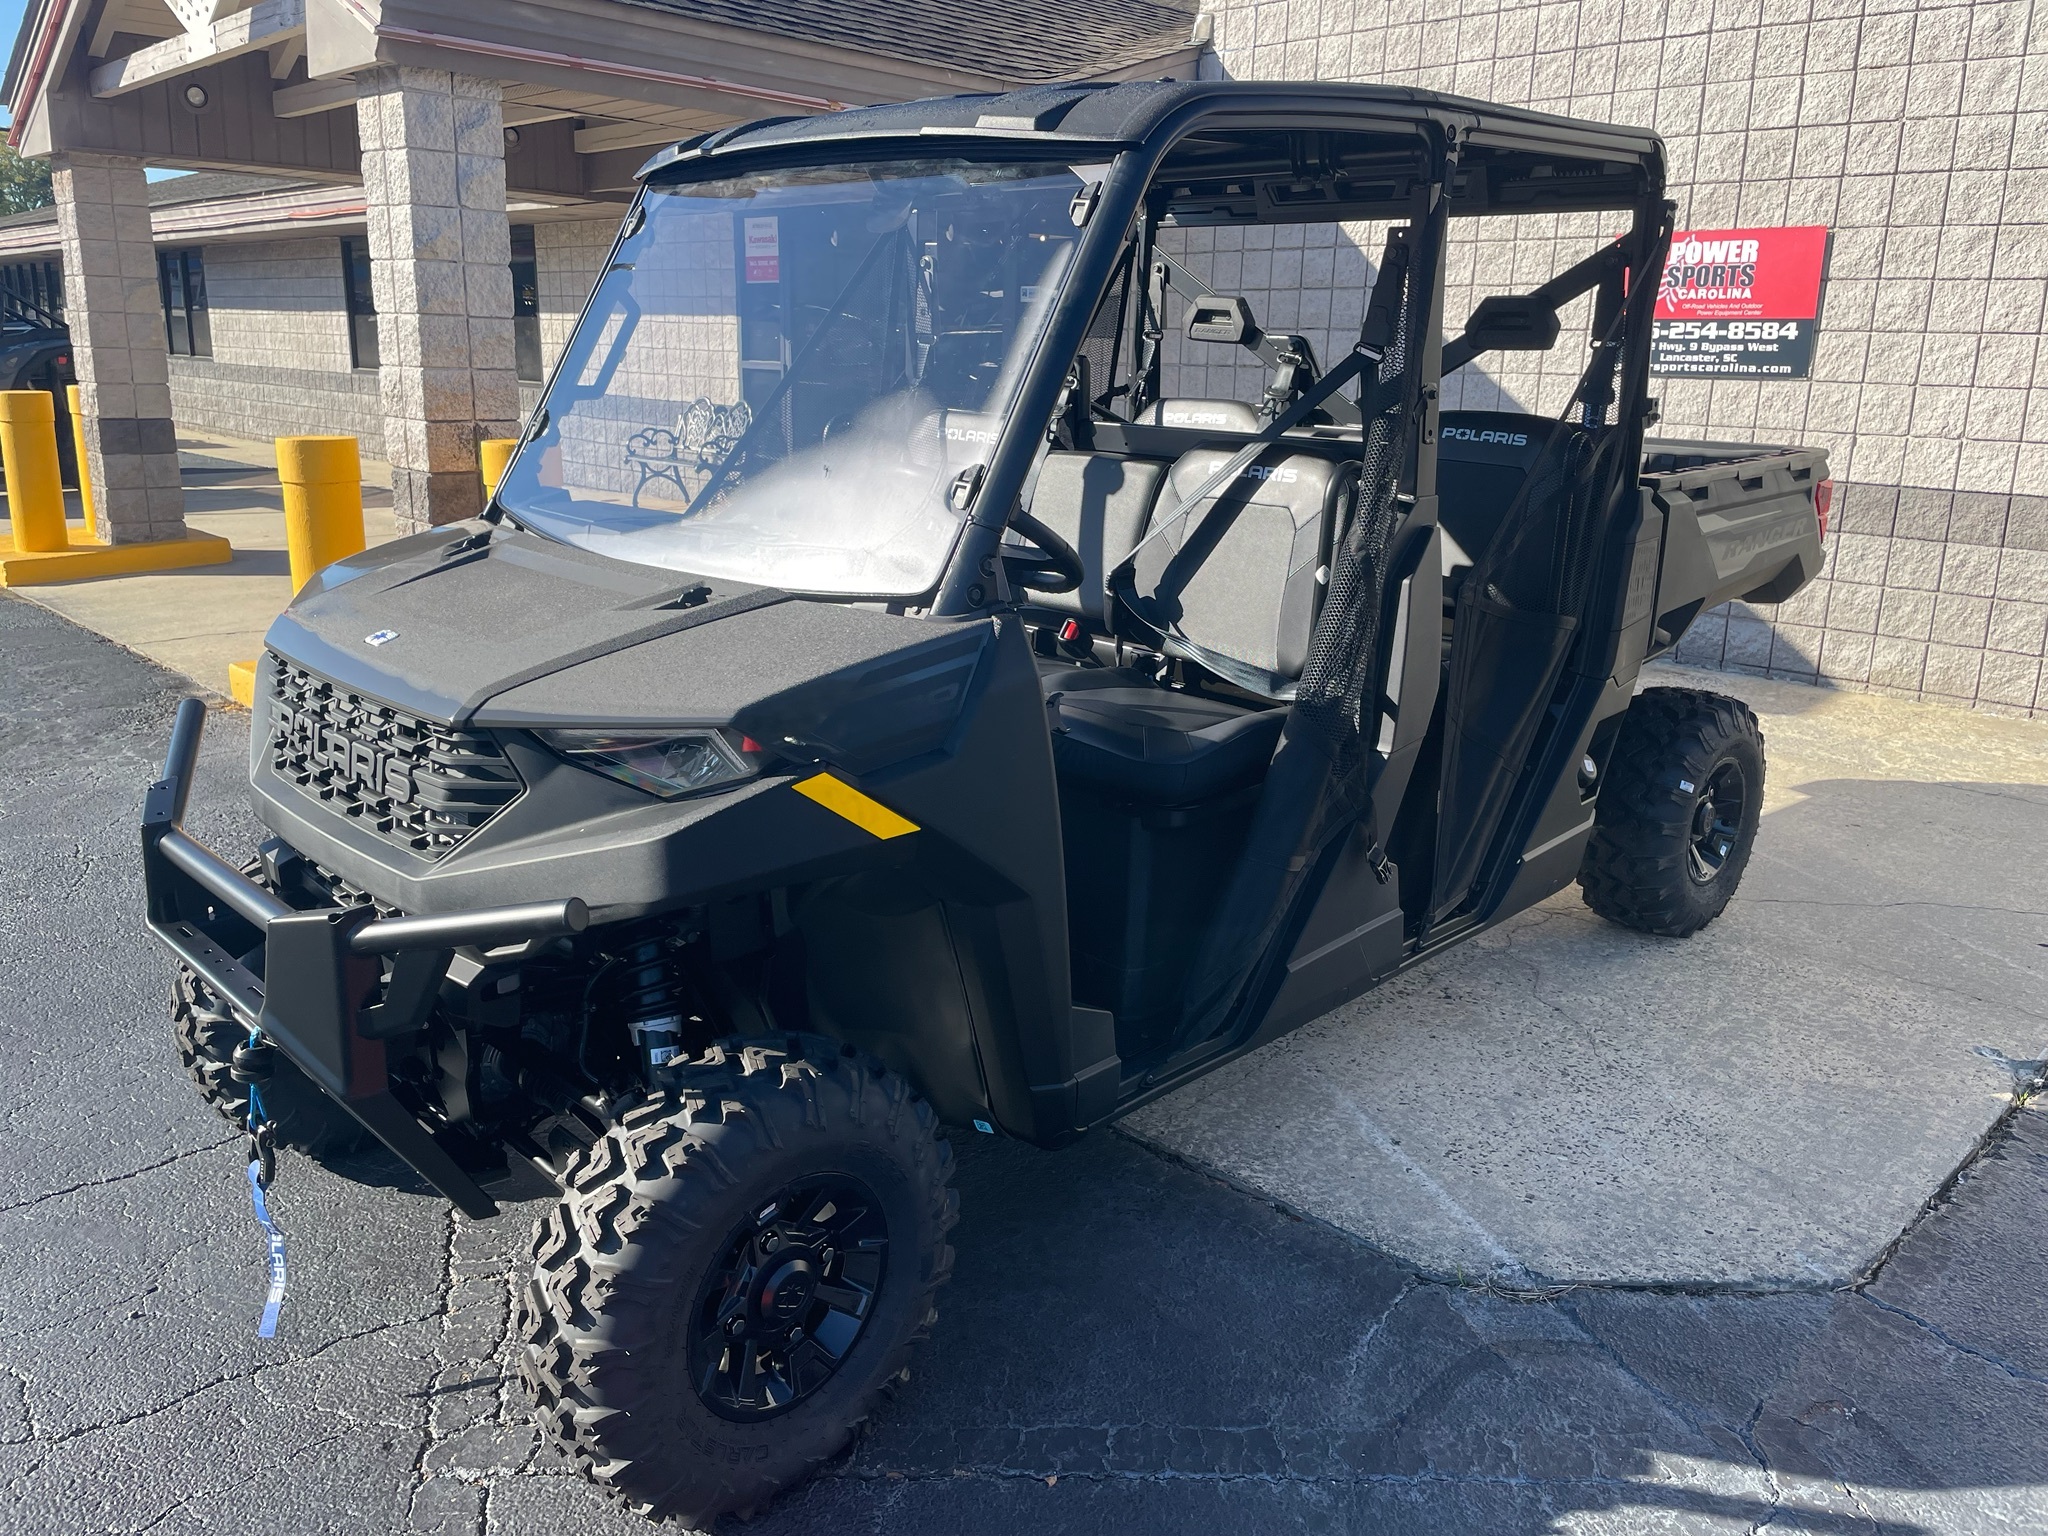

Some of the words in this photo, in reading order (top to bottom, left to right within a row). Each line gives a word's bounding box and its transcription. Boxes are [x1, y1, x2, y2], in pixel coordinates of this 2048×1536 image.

[1668, 240, 1759, 264] POWER
[1666, 264, 1756, 288] SPORTS
[1679, 288, 1752, 300] CAROLINA
[1658, 342, 1686, 353] Hwy.
[1689, 342, 1698, 351] 9
[1701, 342, 1744, 353] Bypass
[1747, 342, 1779, 352] West
[1660, 353, 1719, 363] Lancaster,
[1723, 353, 1738, 363] SC
[1163, 412, 1227, 425] POLARIS
[1442, 427, 1528, 446] POLARIS
[1208, 460, 1298, 483] PLARIS
[1721, 516, 1809, 561] RANGER
[276, 702, 414, 803] POLARIS
